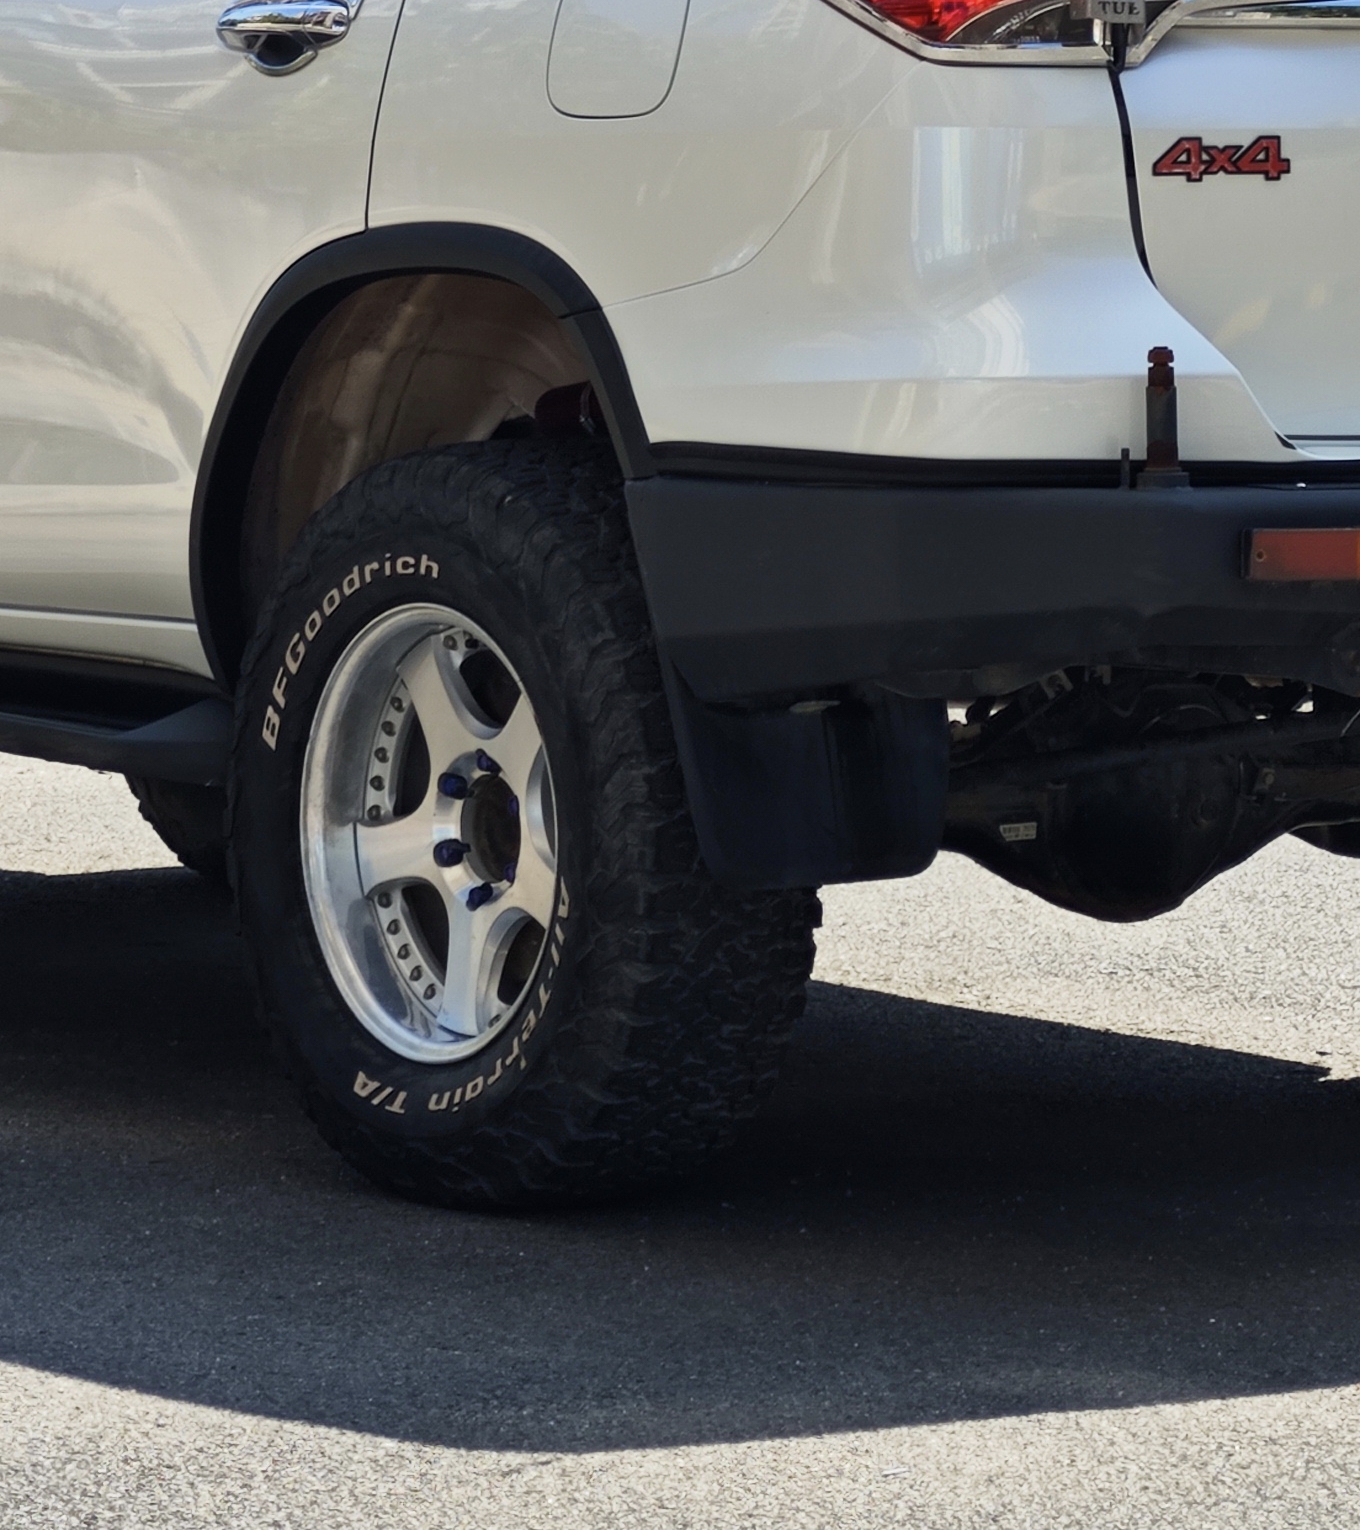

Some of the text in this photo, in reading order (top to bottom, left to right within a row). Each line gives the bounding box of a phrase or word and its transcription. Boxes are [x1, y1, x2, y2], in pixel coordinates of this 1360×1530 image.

[1152, 135, 1291, 182] 4x4
[262, 553, 439, 751] BFGoodrich
[352, 1071, 408, 1114] T/A
